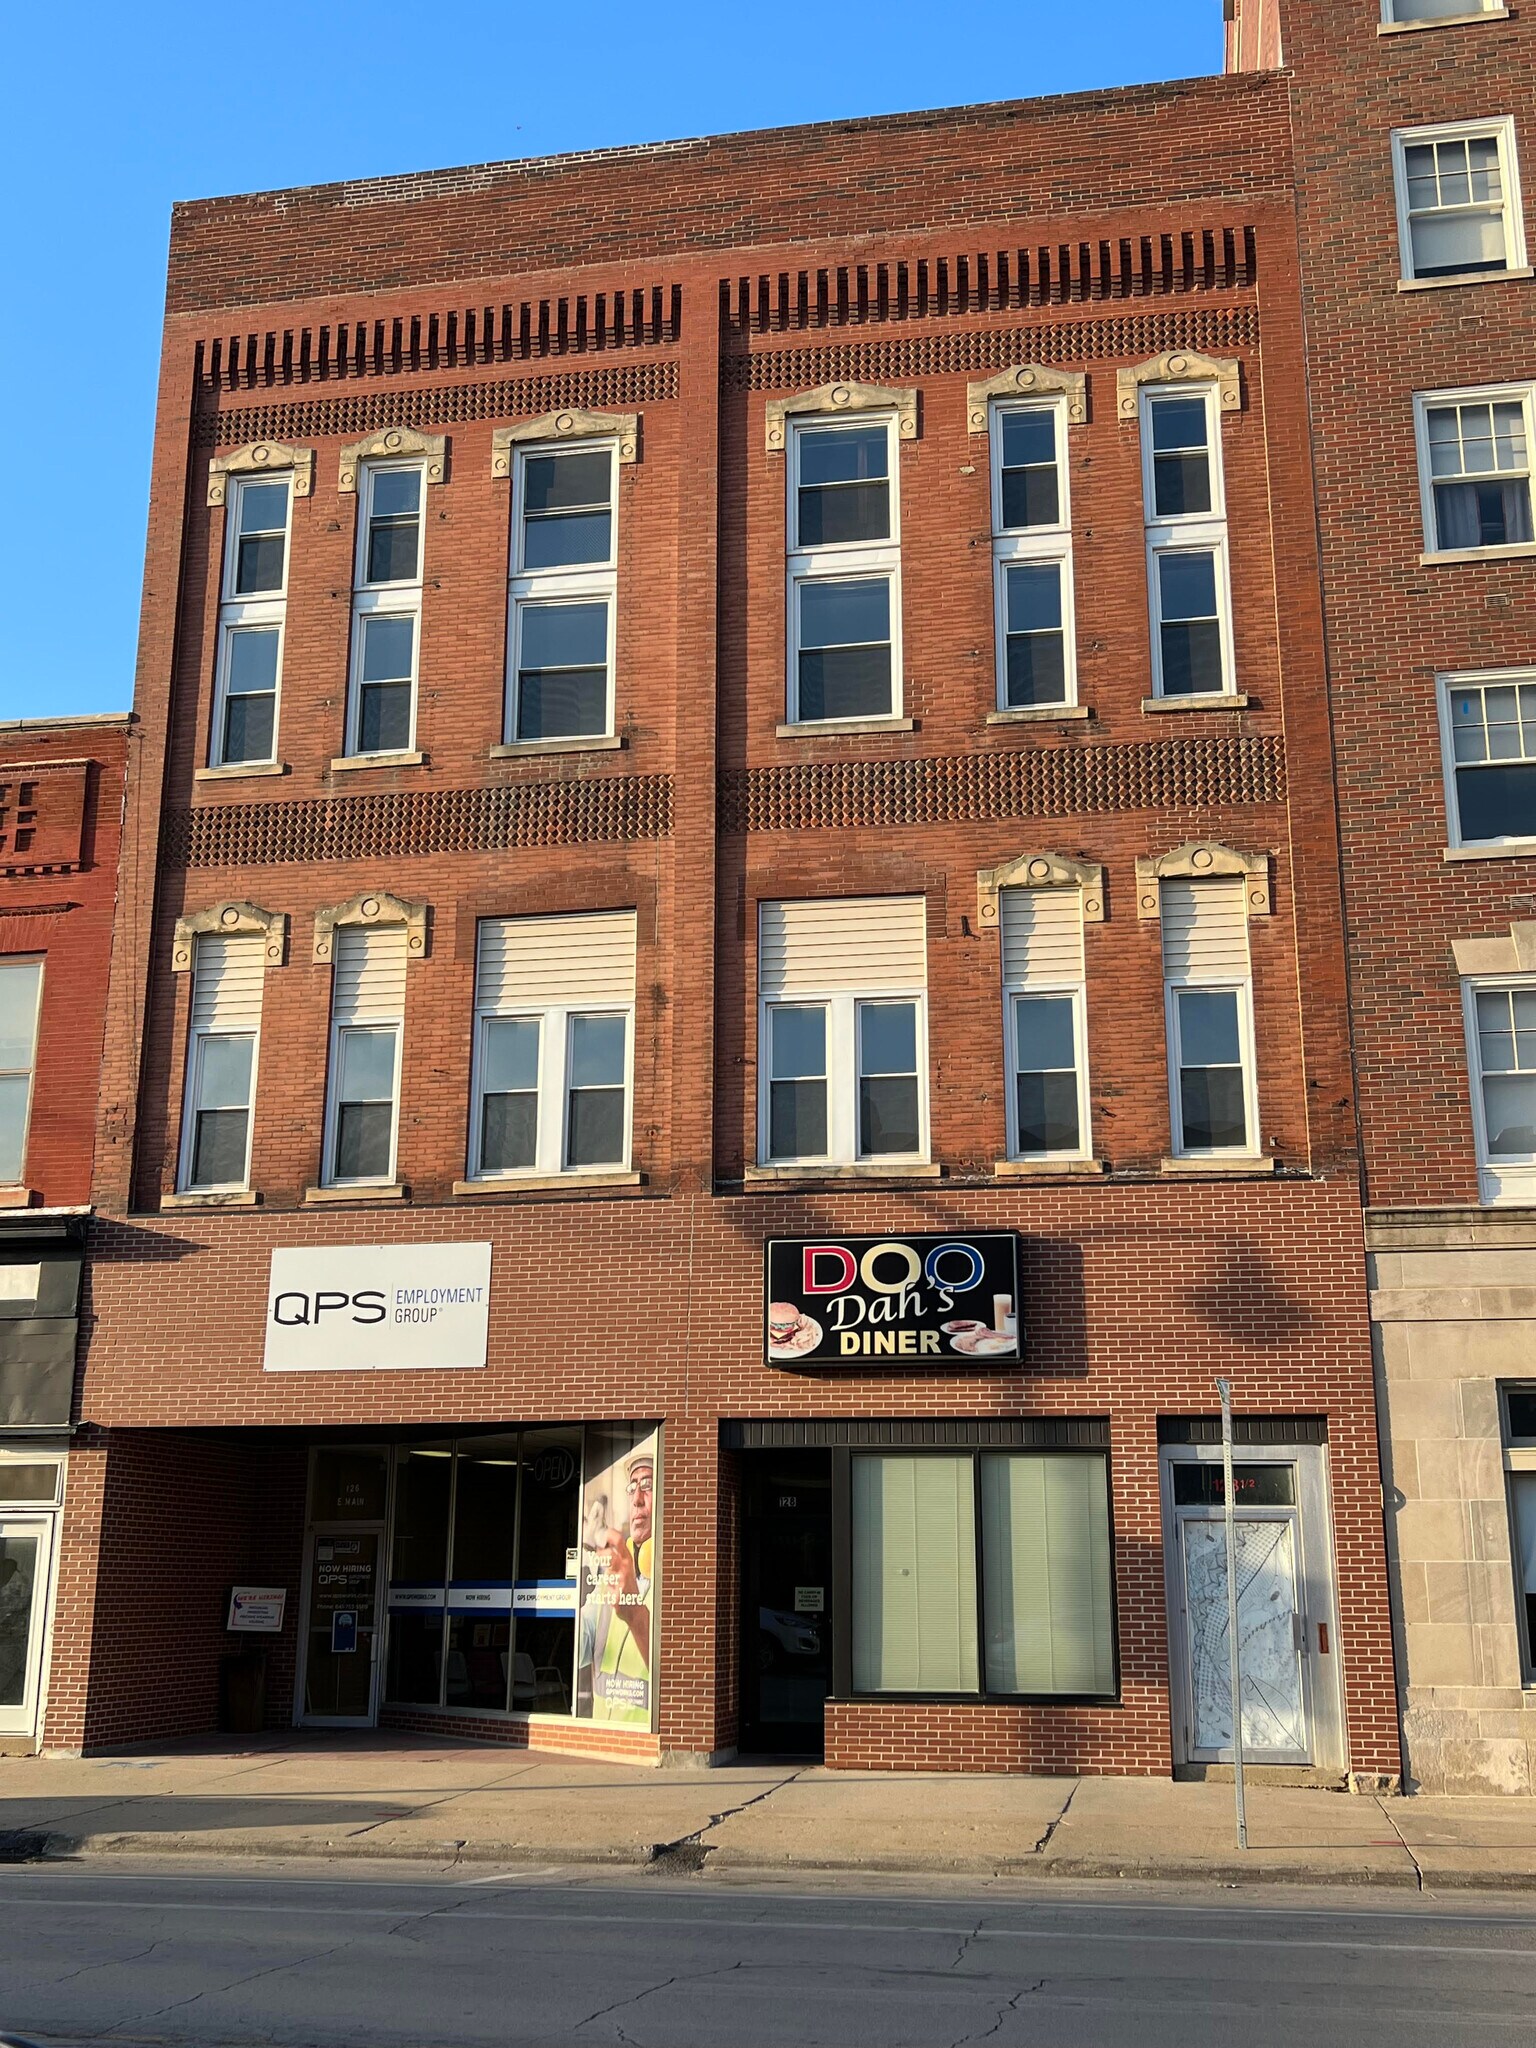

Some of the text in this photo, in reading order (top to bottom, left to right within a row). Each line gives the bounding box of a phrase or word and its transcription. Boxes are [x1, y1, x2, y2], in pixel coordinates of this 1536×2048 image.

[802, 1242, 985, 1295] DOO
[396, 1287, 483, 1305] EMPLOYMENT
[826, 1275, 955, 1331] Dah's
[274, 1290, 386, 1325] QPS
[840, 1330, 942, 1355] DINER
[535, 1455, 568, 1481] OPEN
[346, 1484, 360, 1493] 126
[780, 1497, 796, 1507] 128
[589, 1551, 612, 1566] Your
[319, 1565, 372, 1573] NOW HIRING
[318, 1575, 348, 1585] QPS
[586, 1573, 621, 1585] career
[586, 1588, 646, 1605] starts here.
[605, 1679, 645, 1690] NOW HIRING
